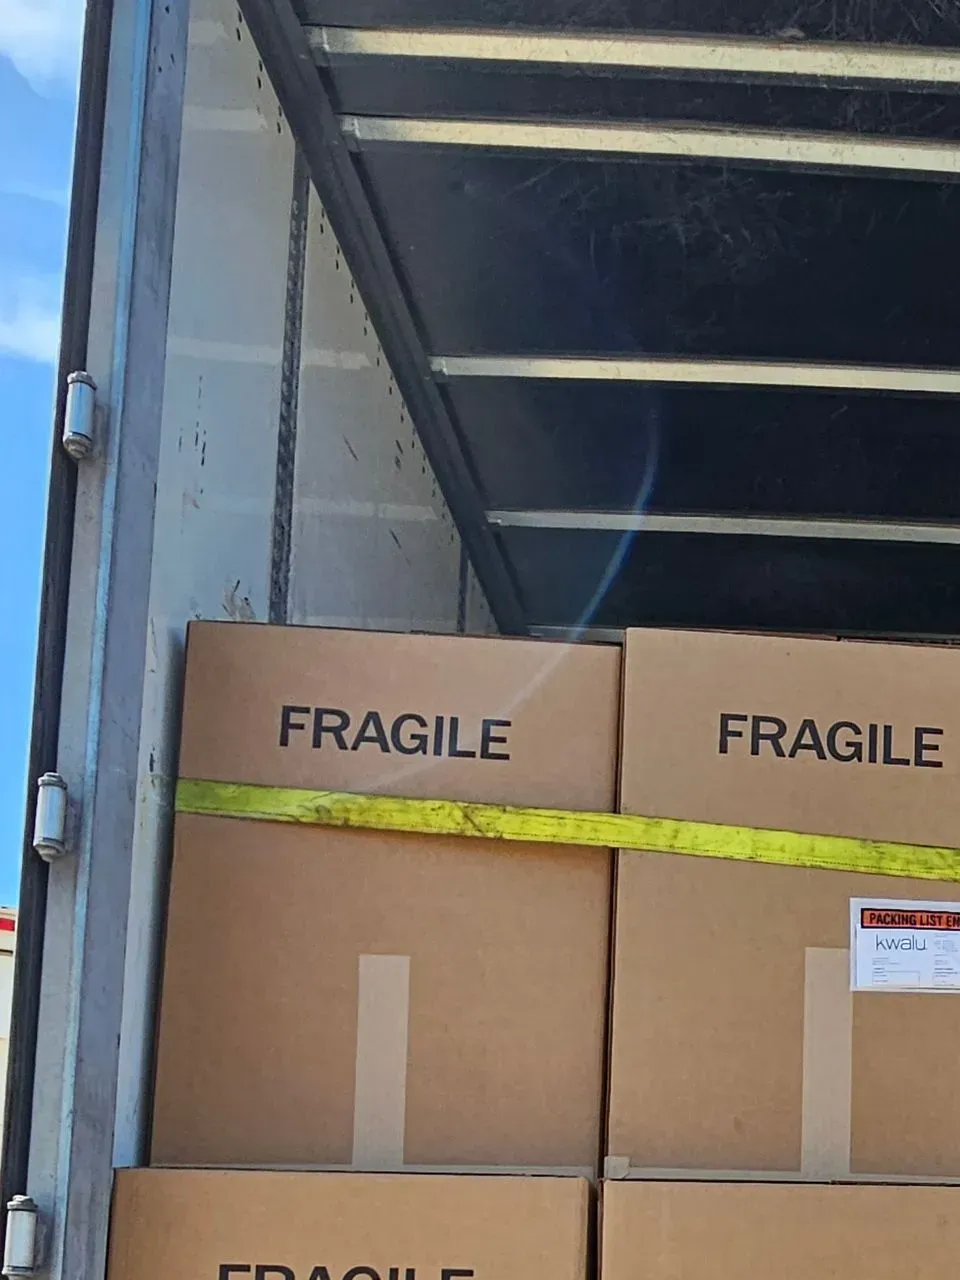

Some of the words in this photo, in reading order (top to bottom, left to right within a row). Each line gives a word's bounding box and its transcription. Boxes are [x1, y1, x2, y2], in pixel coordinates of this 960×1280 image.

[280, 706, 512, 761] FRAGILE
[719, 713, 944, 768] FRAGILE
[869, 912, 917, 926] PACKING
[919, 914, 944, 928] LIST
[875, 934, 927, 951] kwalu
